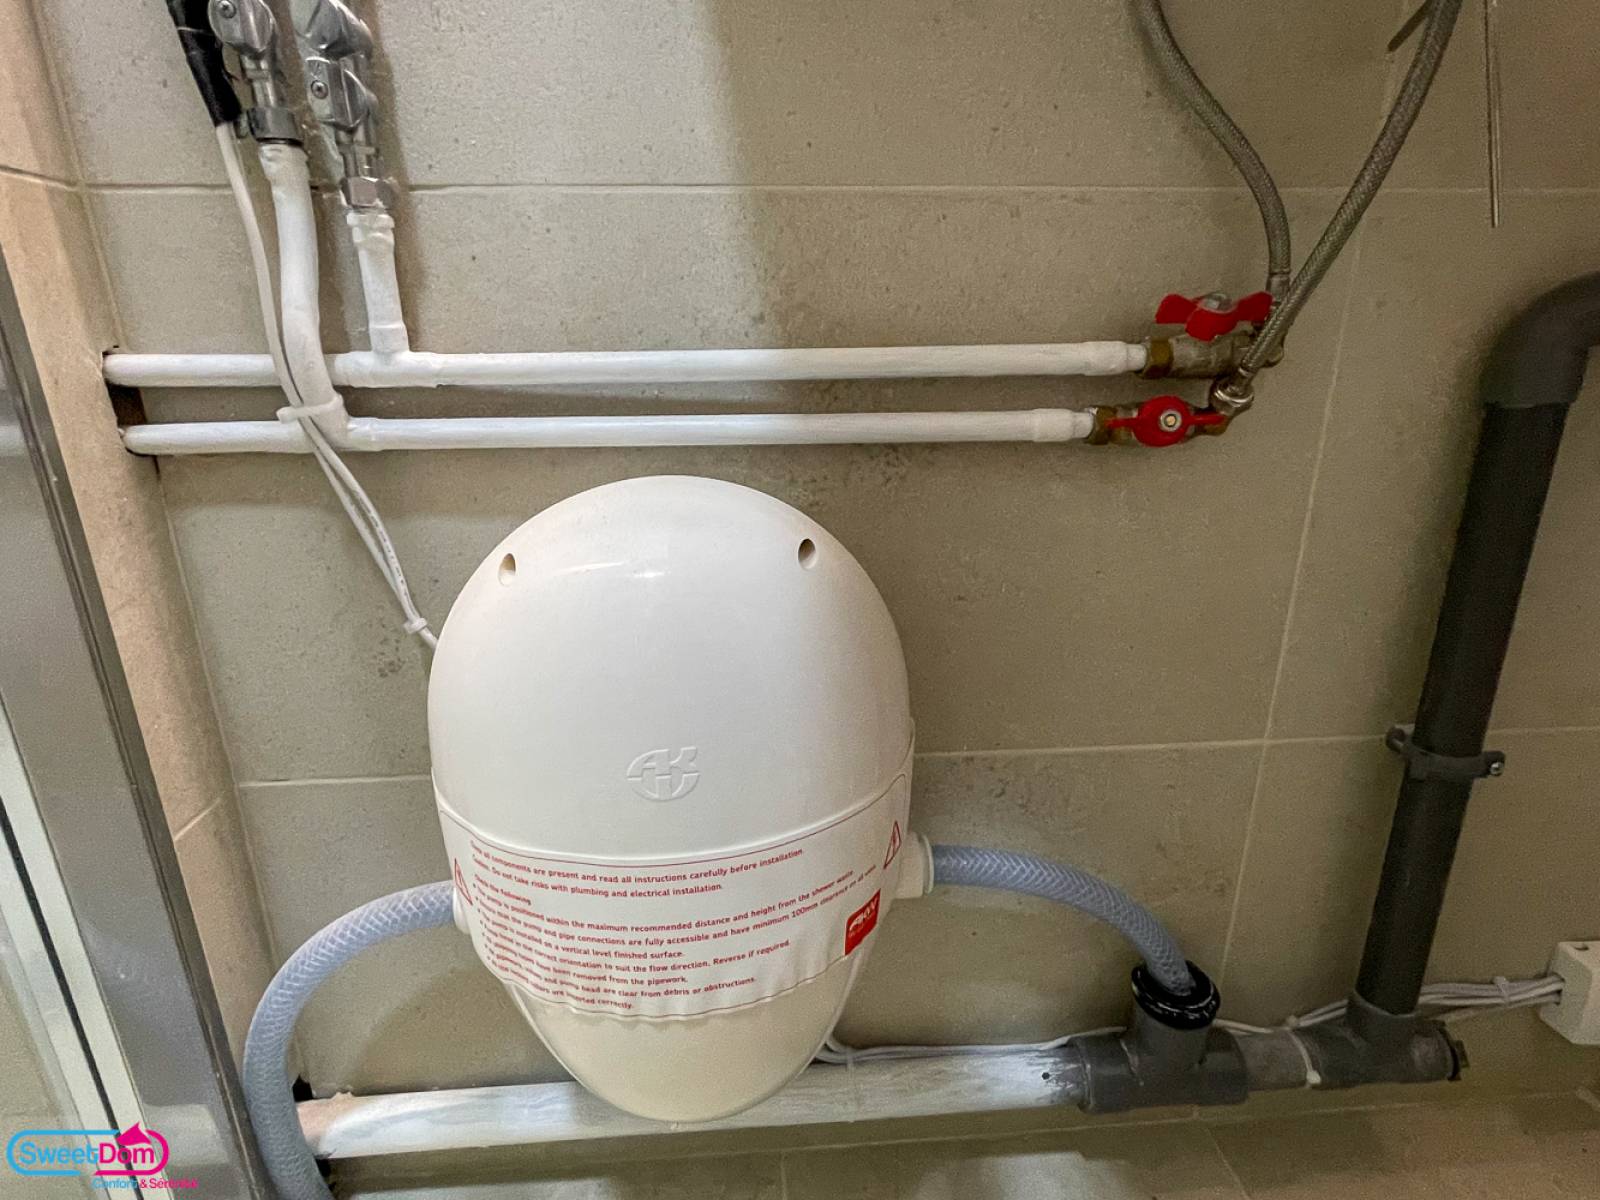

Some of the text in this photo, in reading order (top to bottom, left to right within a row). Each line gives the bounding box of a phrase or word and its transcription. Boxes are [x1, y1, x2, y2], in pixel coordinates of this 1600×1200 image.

[548, 870, 579, 880] present
[600, 875, 618, 883] read
[634, 874, 687, 883] instructions
[690, 868, 728, 880] carefully
[730, 862, 757, 874] before
[514, 875, 528, 885] take
[532, 881, 549, 890] risks
[551, 884, 569, 893] with
[571, 886, 609, 897] plumbing
[611, 889, 627, 897] and
[630, 888, 670, 897] electrical
[546, 917, 569, 927] within
[572, 920, 585, 928] the
[587, 923, 628, 932] maximum
[631, 921, 692, 932] recommended
[695, 916, 731, 929] distance
[733, 912, 749, 922] and
[751, 904, 776, 918] height
[778, 898, 796, 910] from
[798, 893, 810, 902] the
[544, 929, 557, 937] and
[559, 933, 575, 941] pipe
[578, 935, 626, 946] connections
[645, 938, 664, 947] fully
[667, 933, 710, 945] accessible
[713, 929, 729, 940] and
[731, 924, 750, 937] have
[752, 913, 791, 931] minimum
[561, 945, 590, 955] vertical
[592, 949, 612, 958] level
[614, 951, 647, 960] finished
[605, 962, 613, 970] to
[615, 964, 631, 972] suit
[633, 965, 647, 973] the
[650, 964, 668, 973] flow
[671, 960, 711, 972] direction.
[713, 952, 746, 966] Reverse
[573, 971, 607, 981] removed
[609, 975, 629, 985] from
[631, 978, 645, 986] the
[582, 985, 600, 993] head
[641, 989, 661, 998] from
[664, 988, 690, 997] debris
[692, 987, 701, 995] or
